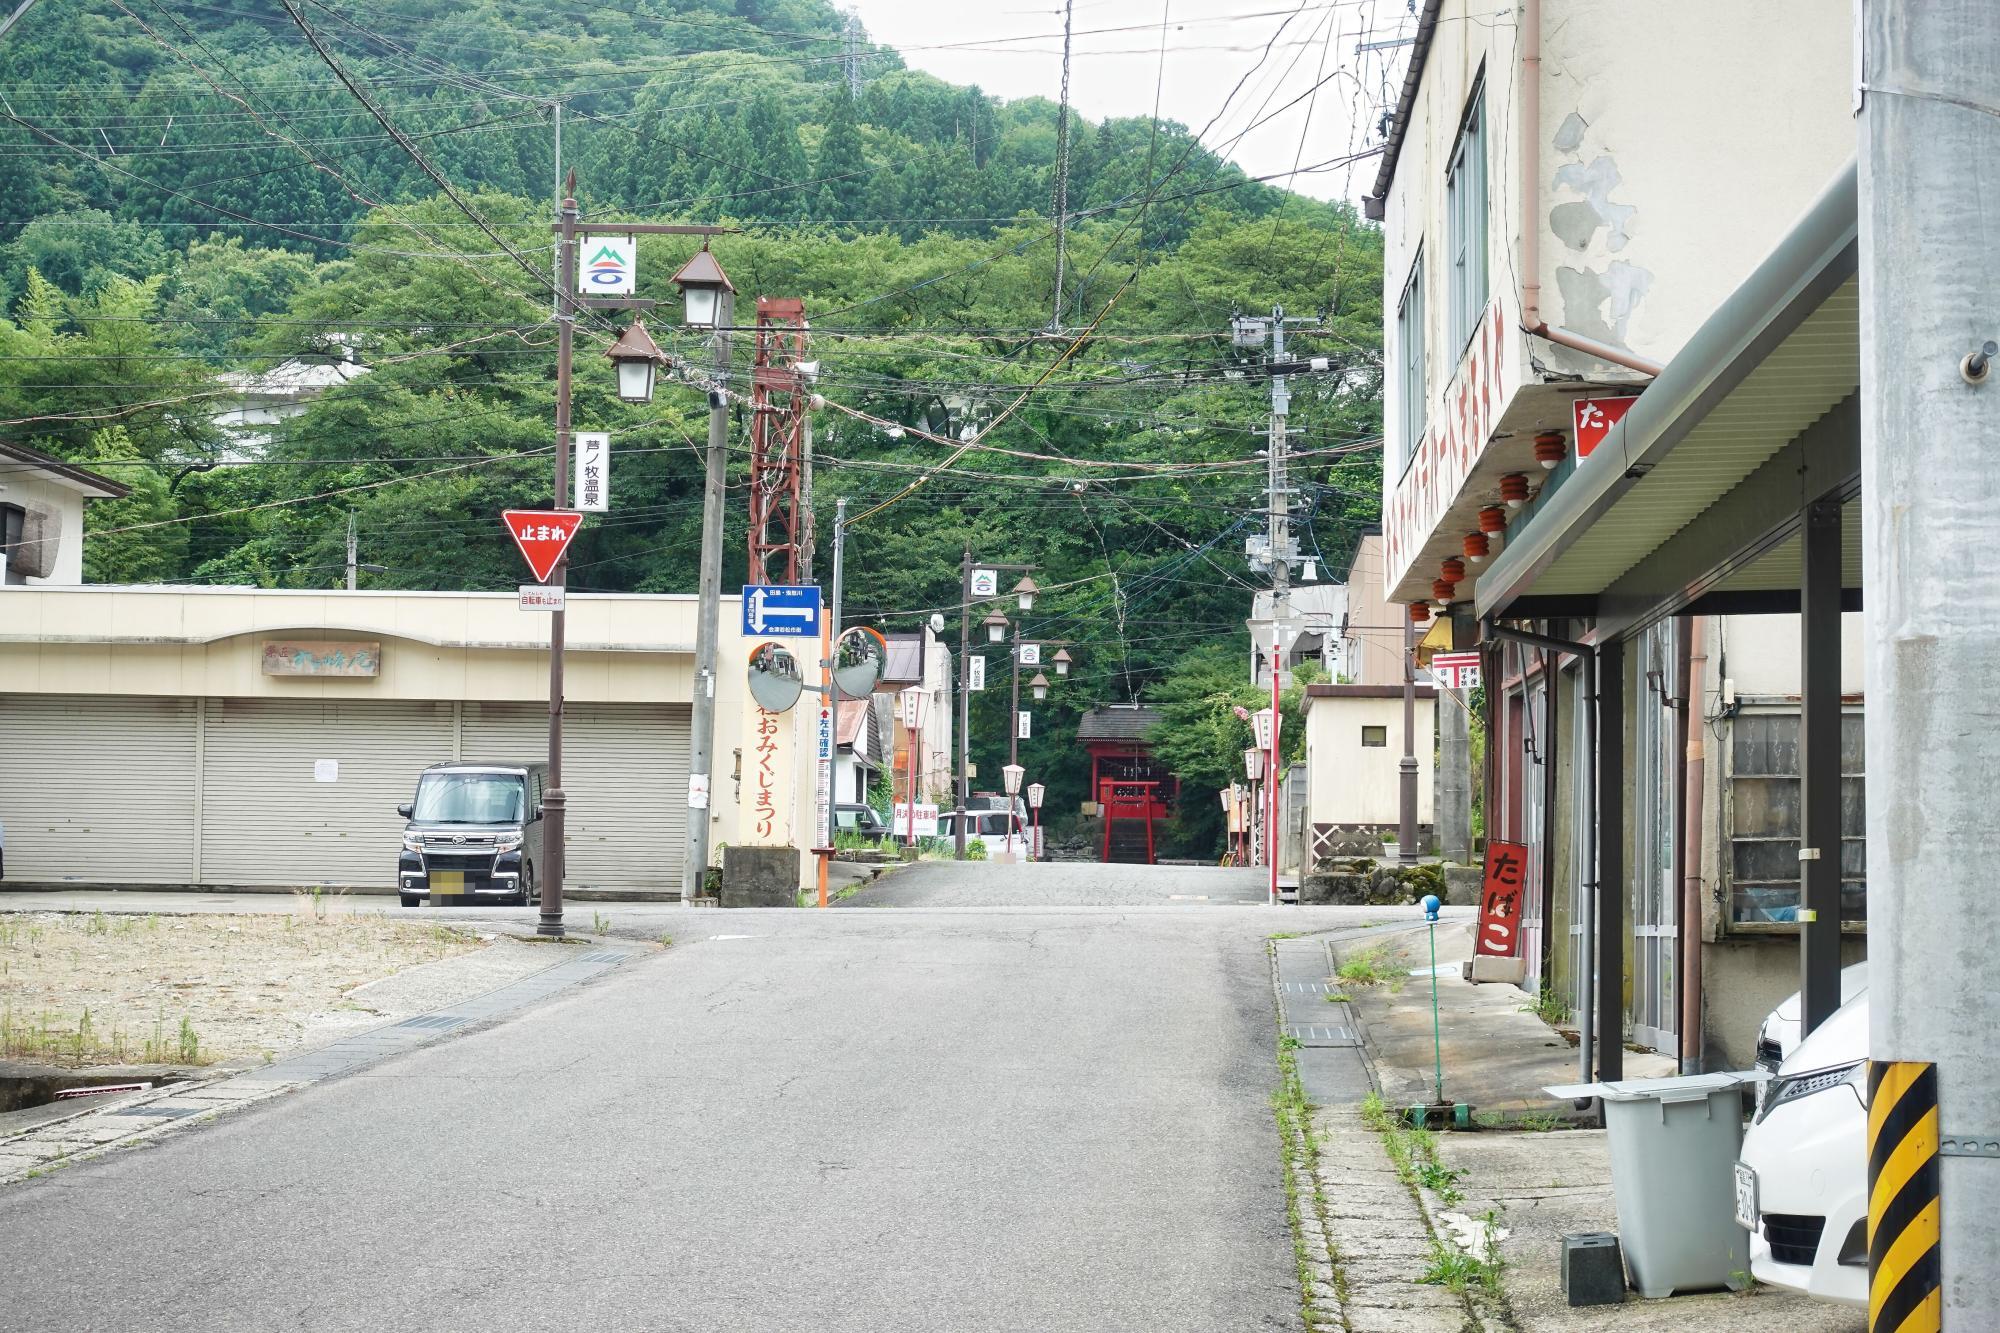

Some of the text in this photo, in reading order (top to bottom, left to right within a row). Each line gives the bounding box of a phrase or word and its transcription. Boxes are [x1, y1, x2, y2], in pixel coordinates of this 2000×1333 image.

[1580, 402, 1615, 432] た
[584, 440, 600, 506] 芦ノ牧温泉
[520, 524, 567, 541] 止まれ
[521, 596, 562, 606] 自転車も止まれ
[819, 719, 829, 757] 左右確認
[1484, 852, 1518, 952] たばこ
